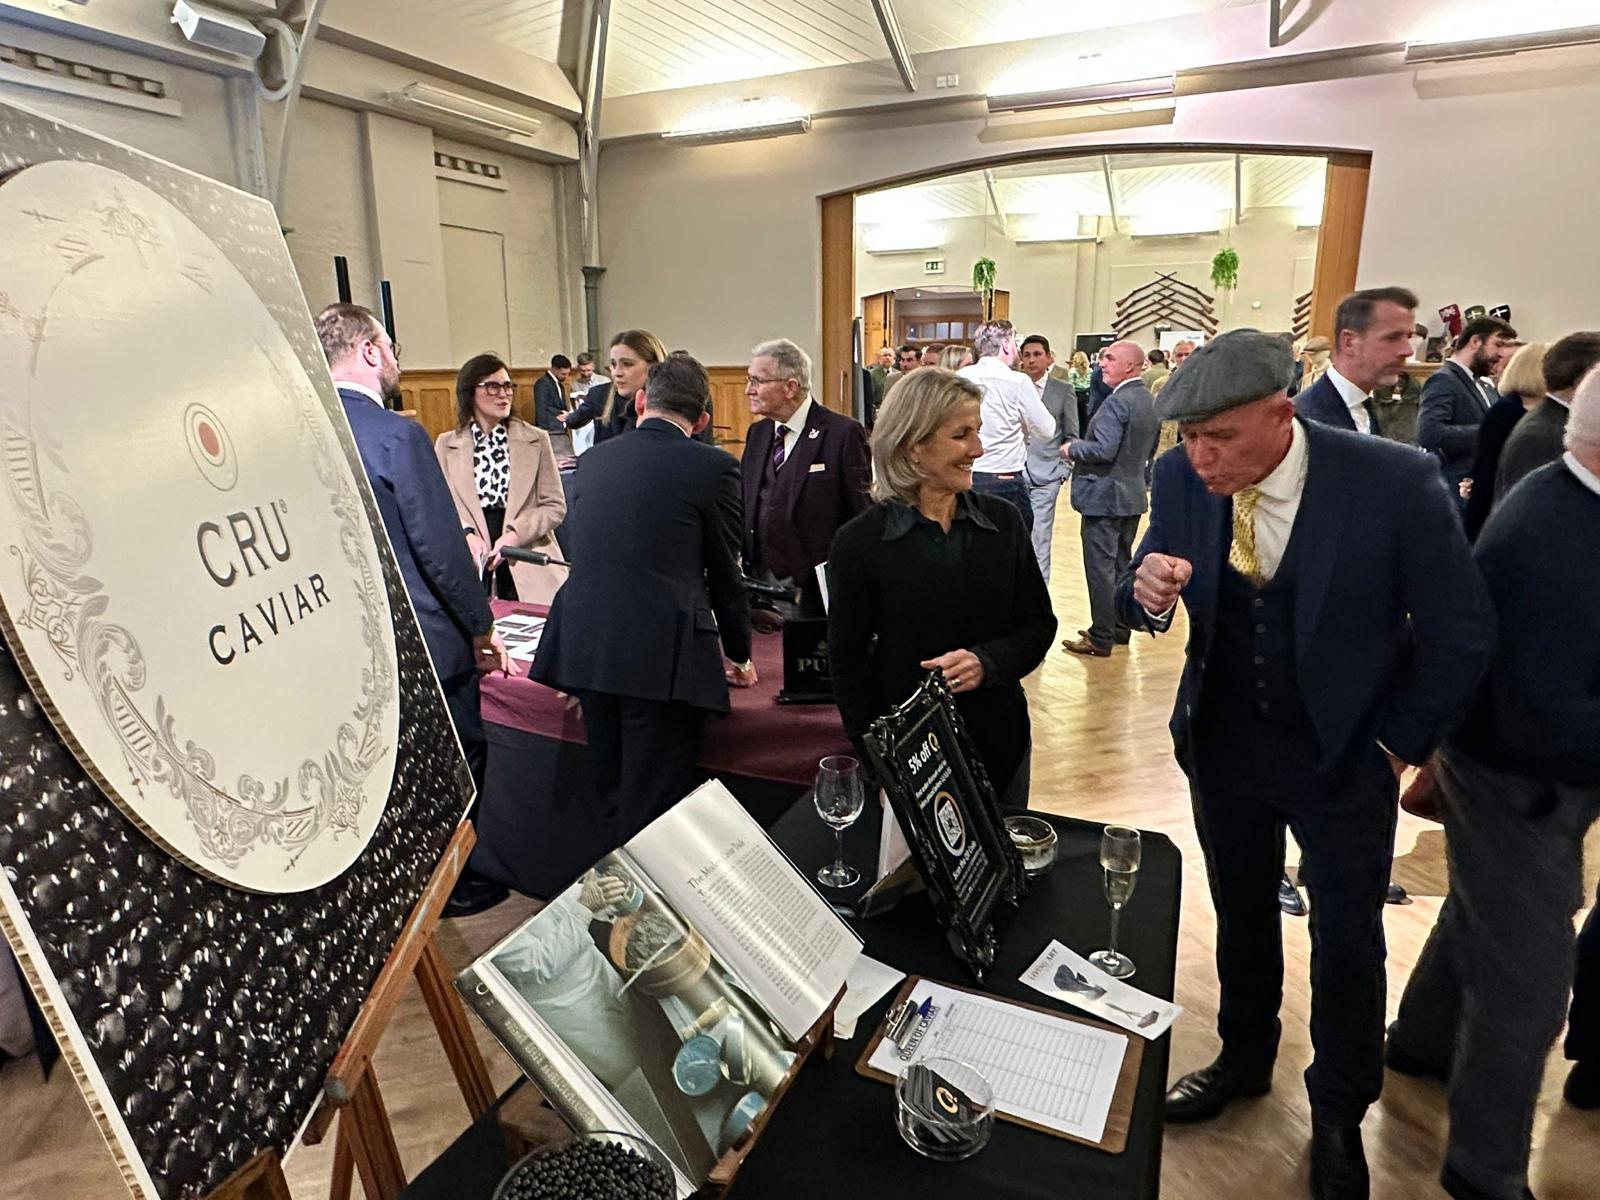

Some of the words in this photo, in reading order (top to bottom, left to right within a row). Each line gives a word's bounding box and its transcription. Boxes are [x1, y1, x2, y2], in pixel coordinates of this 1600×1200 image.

[208, 573, 331, 665] CAVIAR
[797, 658, 827, 672] PU
[908, 752, 922, 775] 5%
[920, 741, 932, 762] off
